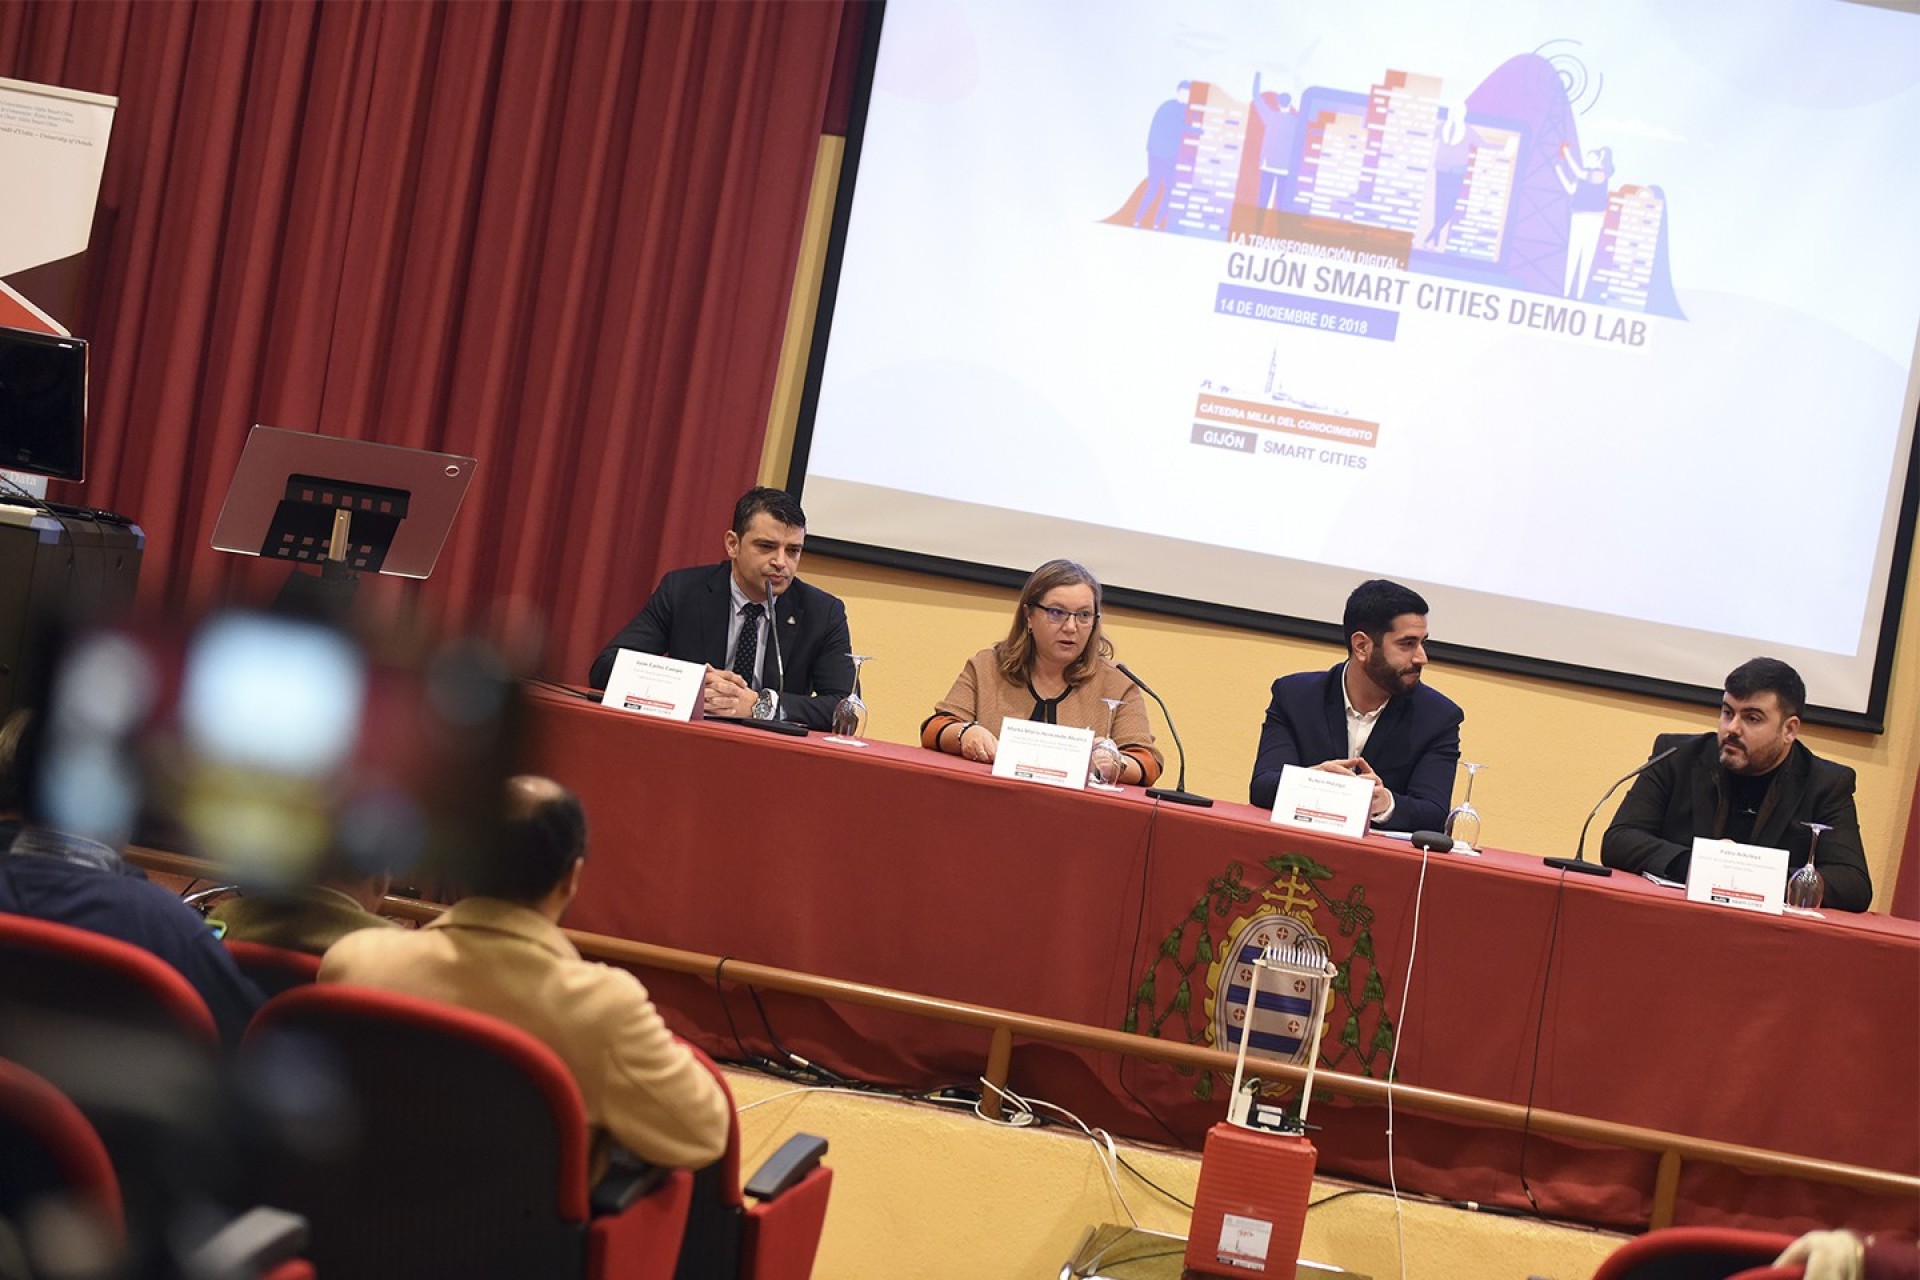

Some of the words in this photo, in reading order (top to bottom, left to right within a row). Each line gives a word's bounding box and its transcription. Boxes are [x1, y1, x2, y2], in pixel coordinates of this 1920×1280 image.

[1231, 231, 1246, 247] LA
[1220, 299, 1234, 313] 14
[1236, 302, 1254, 316] DE
[1255, 305, 1318, 327] DICIEMBRE
[1320, 315, 1338, 330] DE
[1338, 318, 1369, 335] 2018
[1227, 251, 1307, 289] GIJÓN
[1313, 266, 1411, 305] SMART
[1416, 283, 1501, 321] CITIES
[1508, 298, 1587, 337] DEMO
[1594, 313, 1648, 347] LAB
[1200, 402, 1246, 420] CÁTEDRA
[1247, 410, 1276, 426] MILLA
[1277, 416, 1297, 429] DEL
[1298, 419, 1373, 441] CONOCIMIENTO
[1203, 430, 1246, 450] GIJÓN
[1263, 440, 1317, 461] SMART
[1319, 450, 1368, 470] CITIES
